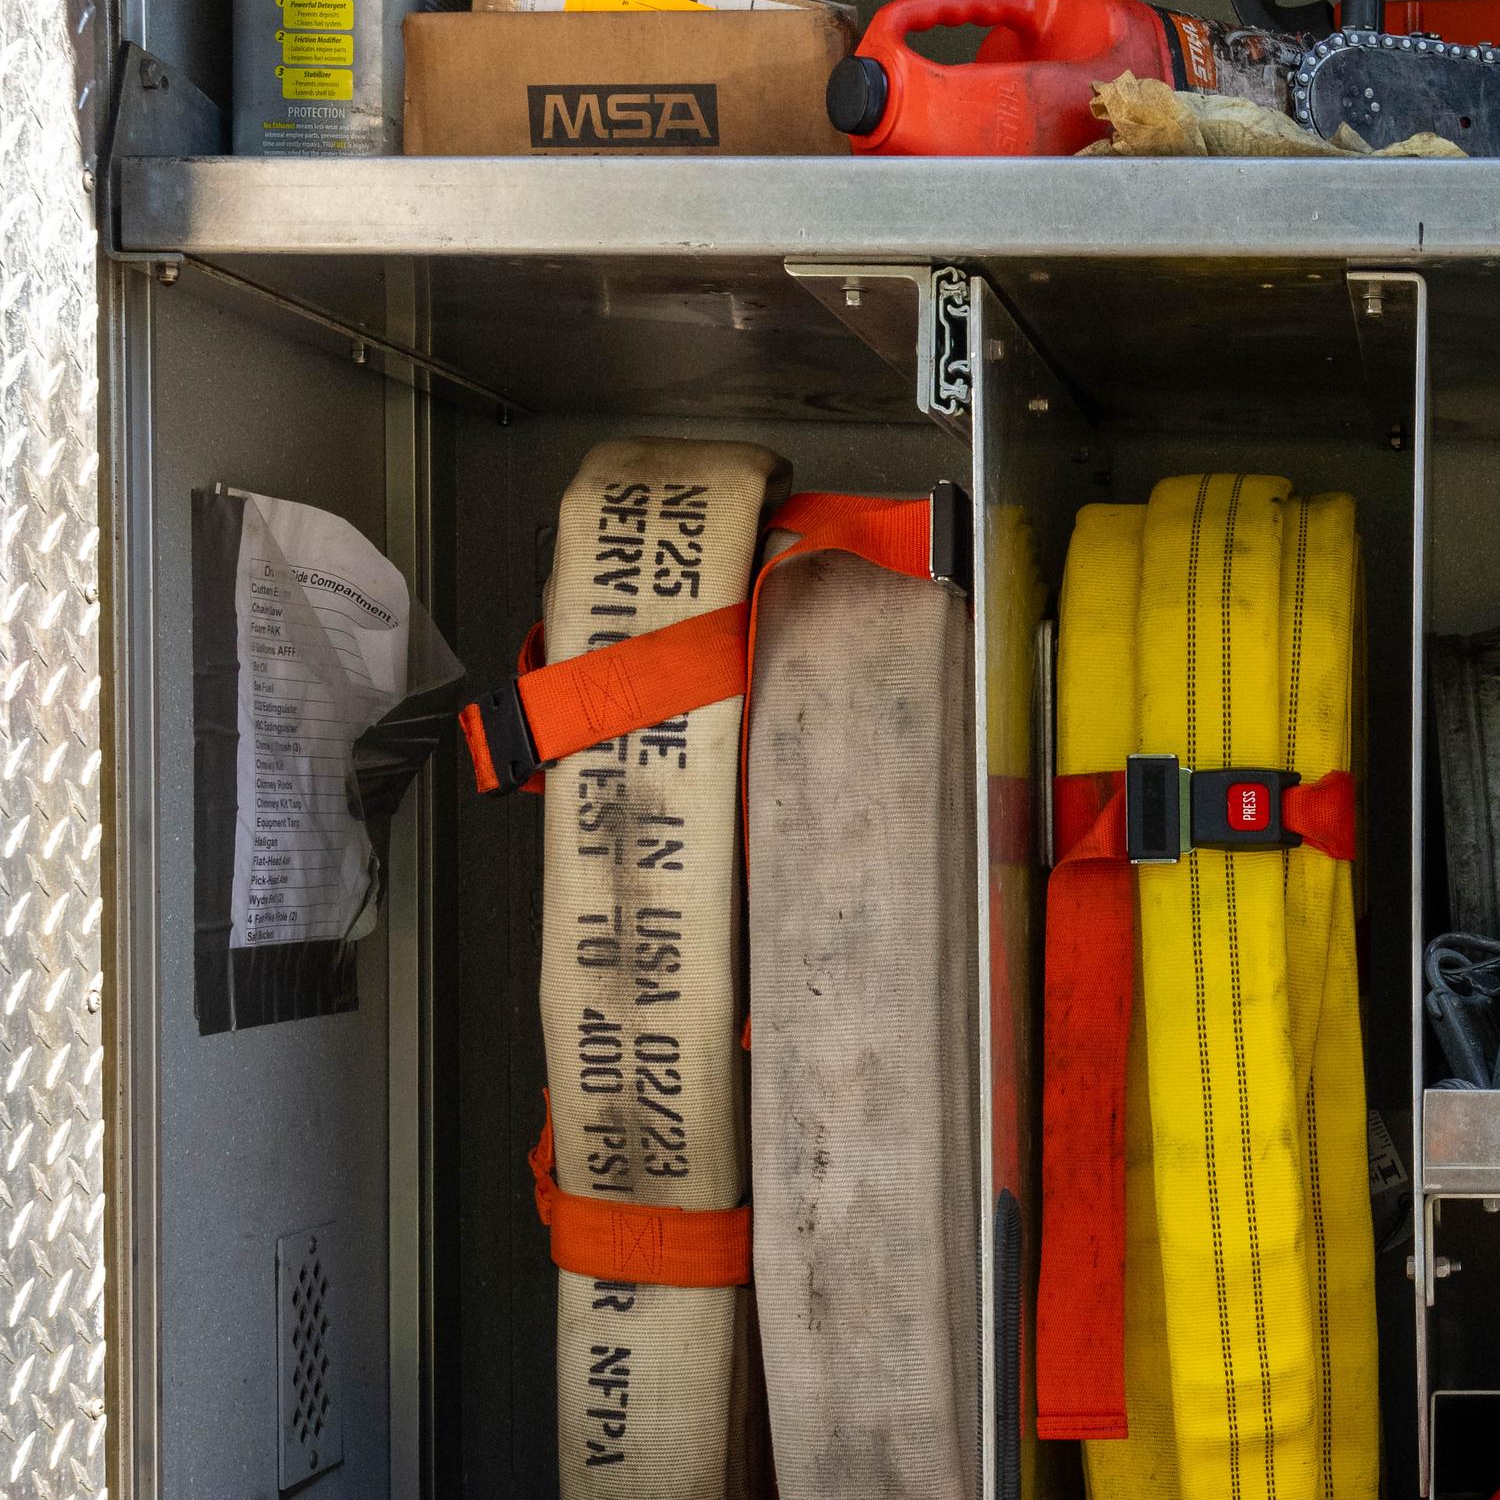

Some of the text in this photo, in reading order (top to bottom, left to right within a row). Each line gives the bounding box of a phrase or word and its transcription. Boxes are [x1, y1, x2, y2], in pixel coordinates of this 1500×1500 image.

[318, 2, 346, 10] Detergent
[278, 68, 284, 76] 3
[1182, 20, 1211, 83] STIHL
[288, 106, 346, 118] PROTECTION
[542, 93, 711, 140] MSA
[310, 573, 392, 623] Compartment
[586, 483, 650, 656] SERVIC
[257, 817, 286, 830] Equipment
[577, 734, 628, 865] TEST
[1242, 791, 1256, 820] PRESS
[254, 836, 278, 849] Haligan
[636, 816, 685, 870] IN
[577, 905, 622, 969] TO
[634, 906, 682, 1006] USA
[578, 1008, 624, 1095] 400
[633, 1033, 690, 1179] 02/23
[580, 1123, 633, 1192] PSI
[585, 1345, 633, 1468] NFPA
